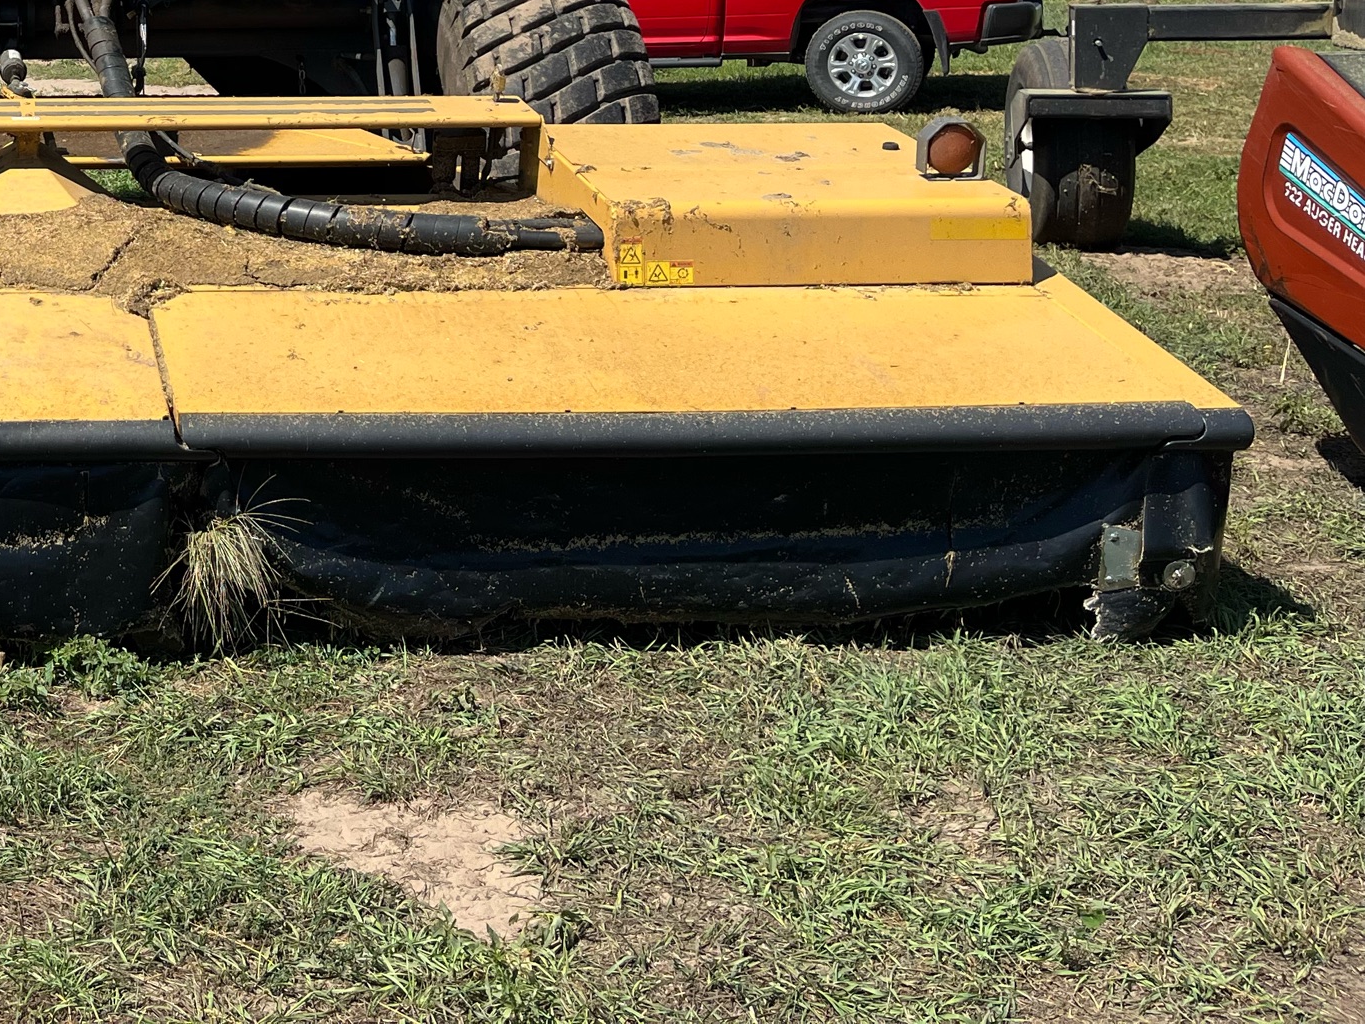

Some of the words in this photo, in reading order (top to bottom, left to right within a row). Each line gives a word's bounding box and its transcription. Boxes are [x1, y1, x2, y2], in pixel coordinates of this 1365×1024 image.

[834, 96, 850, 105] AT
[850, 74, 909, 109] TRANSFORCE
[1290, 147, 1365, 233] MacDo
[1303, 199, 1341, 238] AUGER
[1342, 229, 1365, 261] HEA
